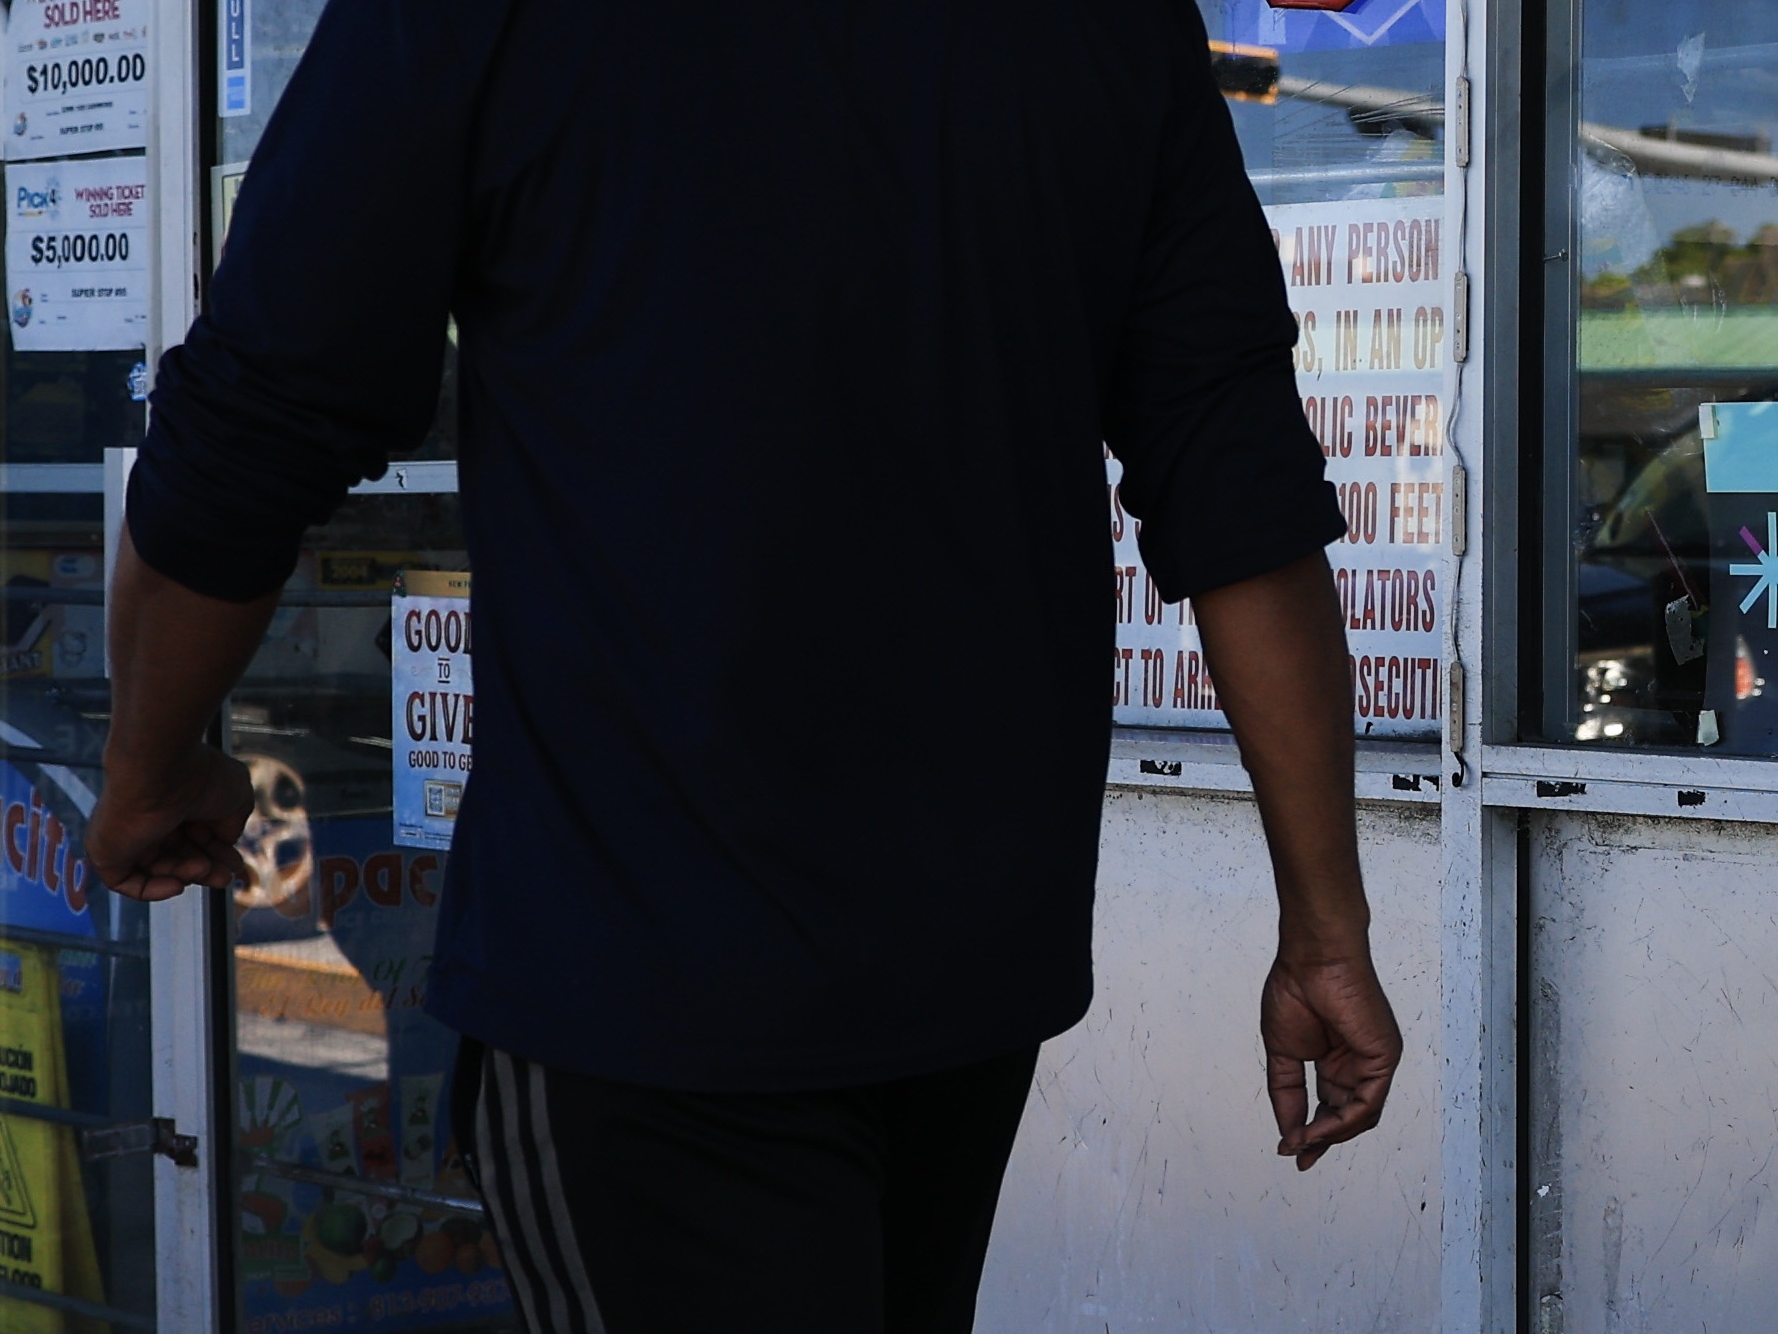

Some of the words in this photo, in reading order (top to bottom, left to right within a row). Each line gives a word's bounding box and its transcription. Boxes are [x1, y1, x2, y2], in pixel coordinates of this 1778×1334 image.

[44, 3, 80, 28] SOLD
[27, 53, 146, 95] $10,000.00
[74, 186, 113, 201] WINNING
[116, 185, 146, 200] TICKET
[89, 203, 110, 218] SOLD
[111, 201, 134, 217] HERE
[31, 233, 130, 268] $5,000.00
[1291, 224, 1337, 287] ANY
[1346, 218, 1441, 285] PERSON
[1335, 309, 1359, 371] IN
[1369, 308, 1402, 370] AN
[1300, 395, 1353, 458] OLIC
[1364, 394, 1443, 457] BEVER
[1339, 481, 1378, 544] 100
[1389, 482, 1443, 544] FEET
[1332, 568, 1436, 633] OLATORS
[438, 662, 450, 680] TO
[1141, 648, 1165, 709] TO
[1173, 649, 1220, 710] ARR
[1350, 655, 1442, 721] SECUTI
[408, 750, 439, 768] GOOD
[442, 751, 455, 769] TO
[0, 785, 86, 912] cito
